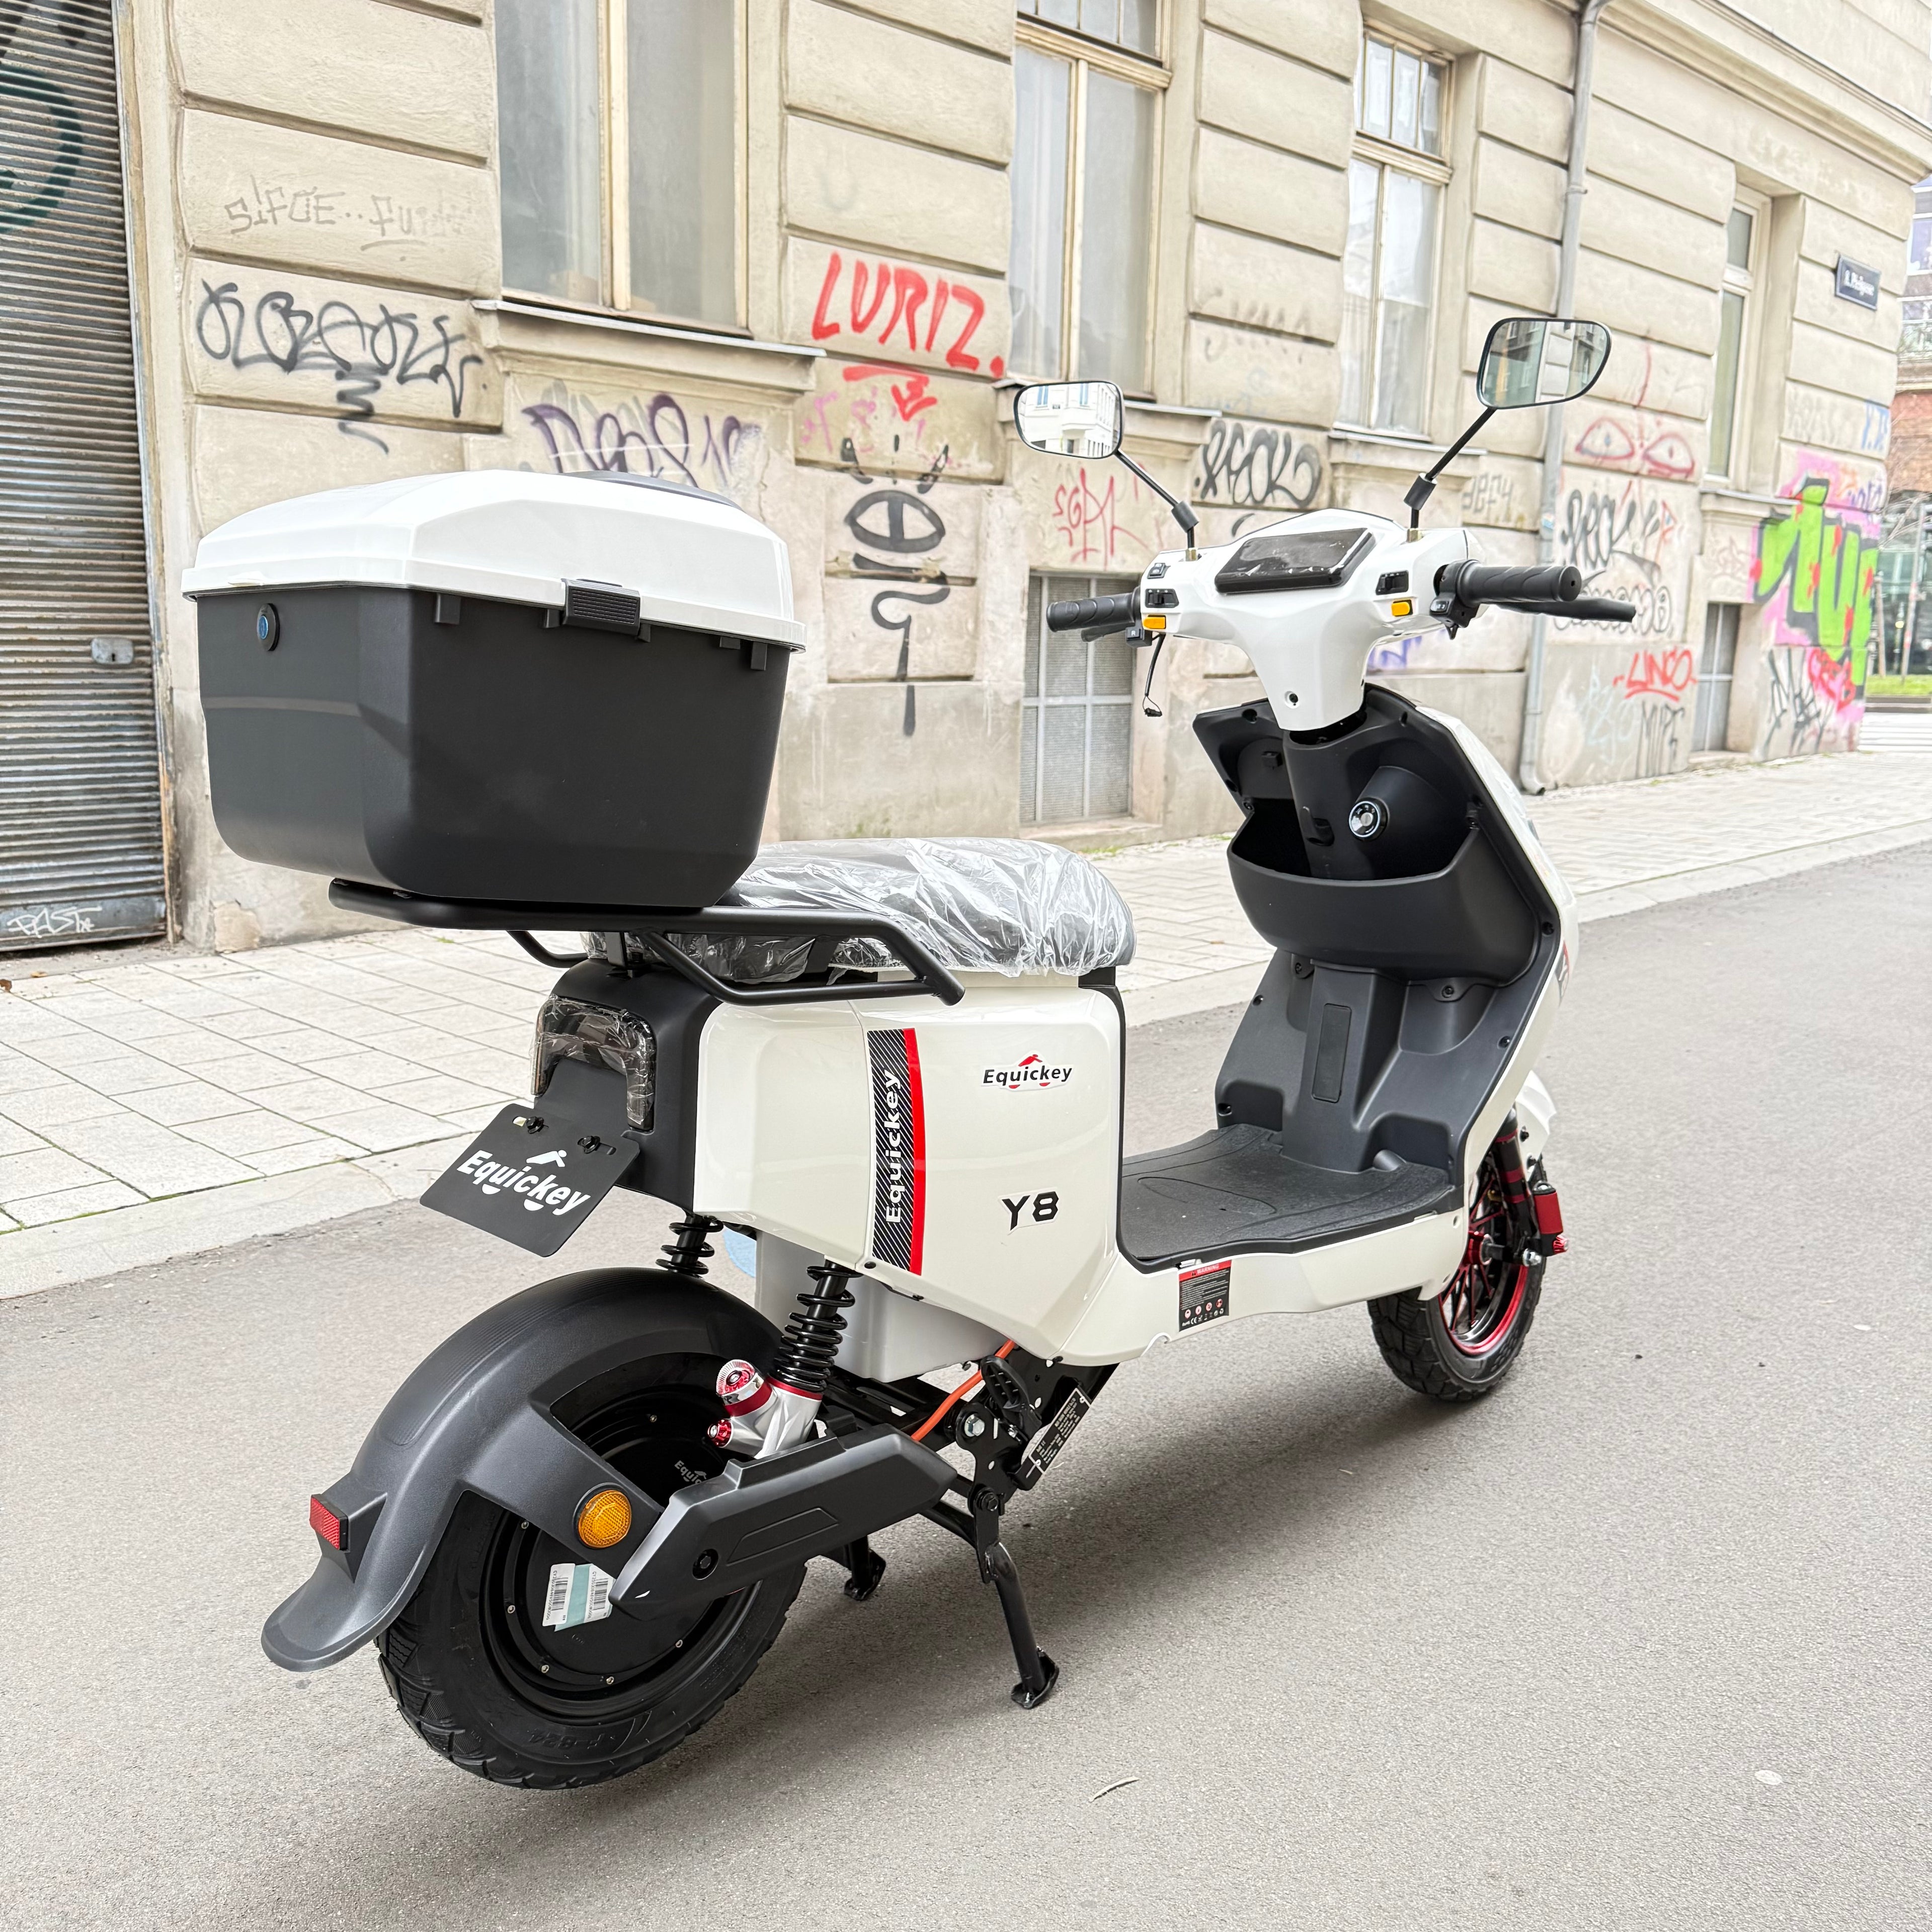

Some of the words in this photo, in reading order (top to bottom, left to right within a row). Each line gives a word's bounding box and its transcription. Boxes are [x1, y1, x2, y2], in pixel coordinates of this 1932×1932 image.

[983, 1064, 1073, 1086] Equickey
[883, 1069, 906, 1223] Equickey
[456, 1150, 591, 1216] Equickey
[1002, 1191, 1059, 1231] Y8
[674, 1460, 702, 1484] Equic
